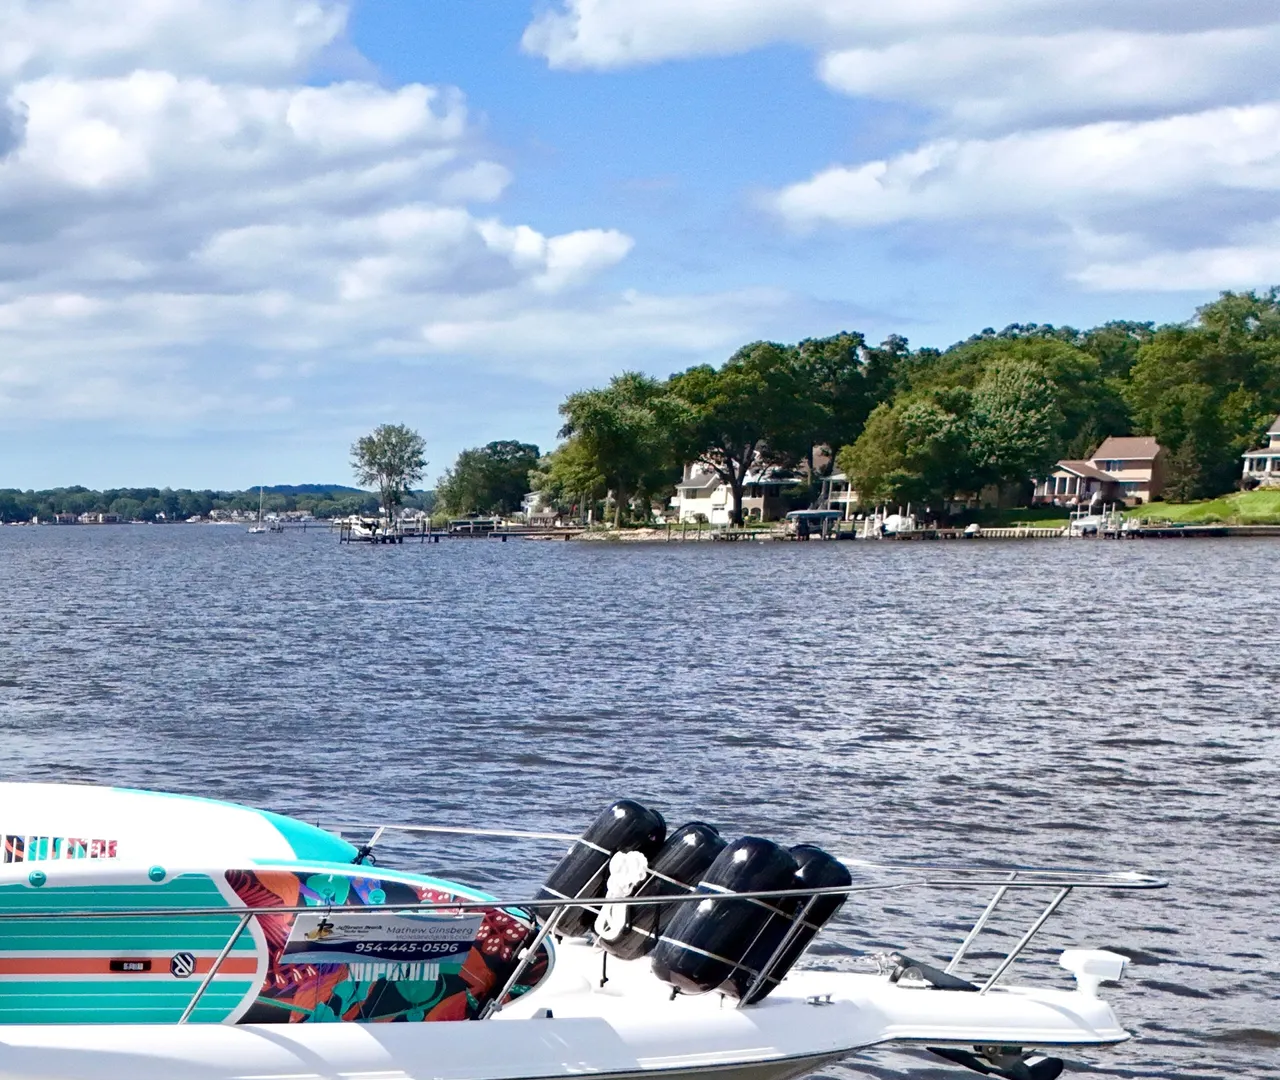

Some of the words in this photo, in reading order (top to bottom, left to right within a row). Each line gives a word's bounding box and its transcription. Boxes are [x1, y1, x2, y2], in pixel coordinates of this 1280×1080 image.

[386, 926, 427, 934] Mathew
[428, 926, 474, 935] Ginsberg
[354, 943, 459, 953] 954-445-0596
